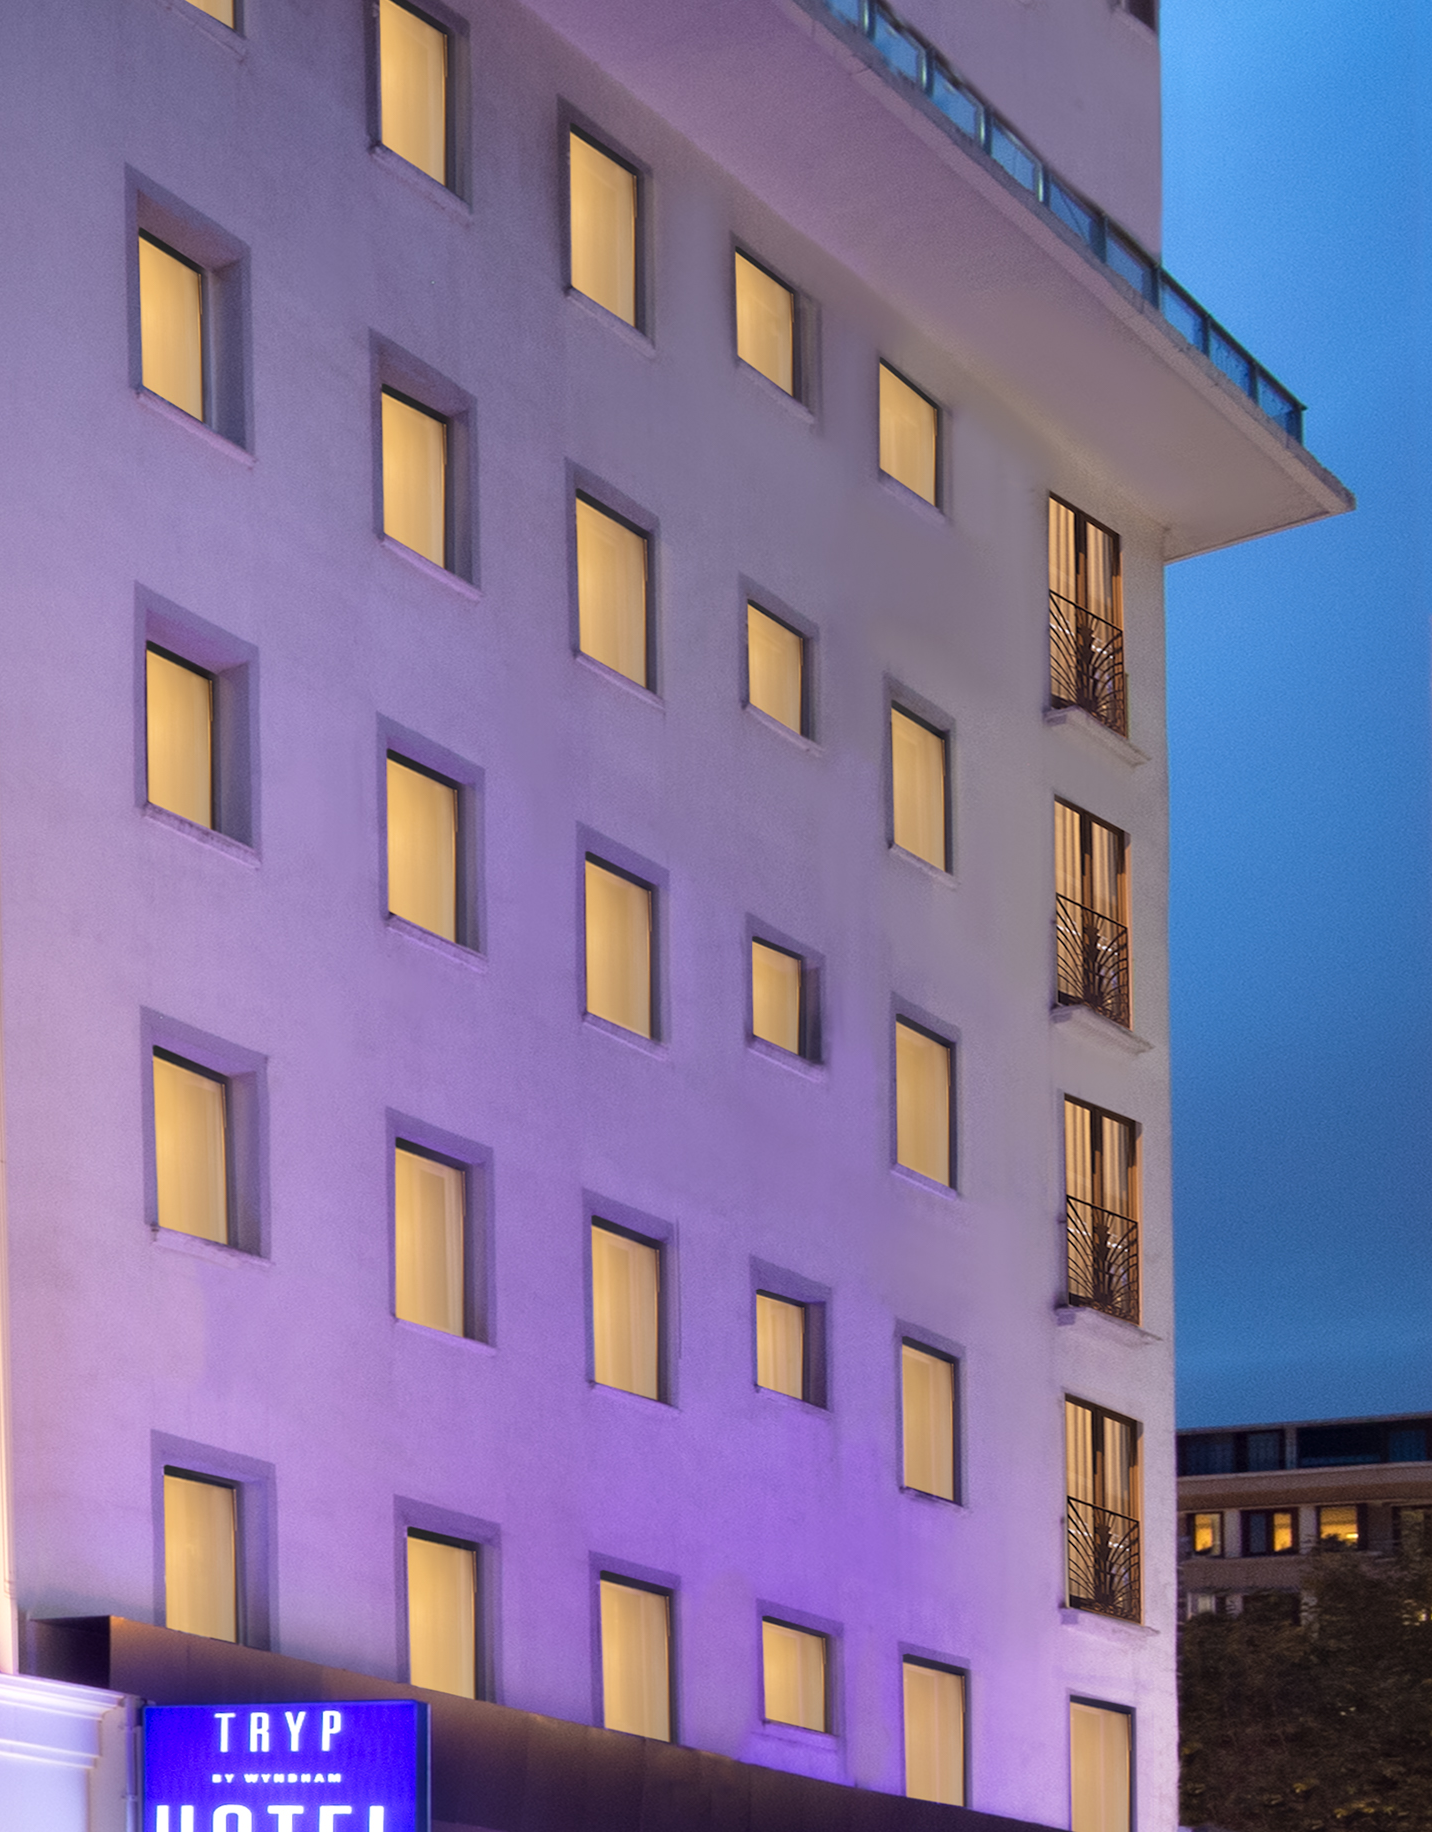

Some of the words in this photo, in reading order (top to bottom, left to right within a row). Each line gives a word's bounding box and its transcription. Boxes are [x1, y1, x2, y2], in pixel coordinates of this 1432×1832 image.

[214, 1710, 343, 1753] TRYP
[212, 1773, 234, 1784] BY
[244, 1772, 343, 1784] WYNDHAM
